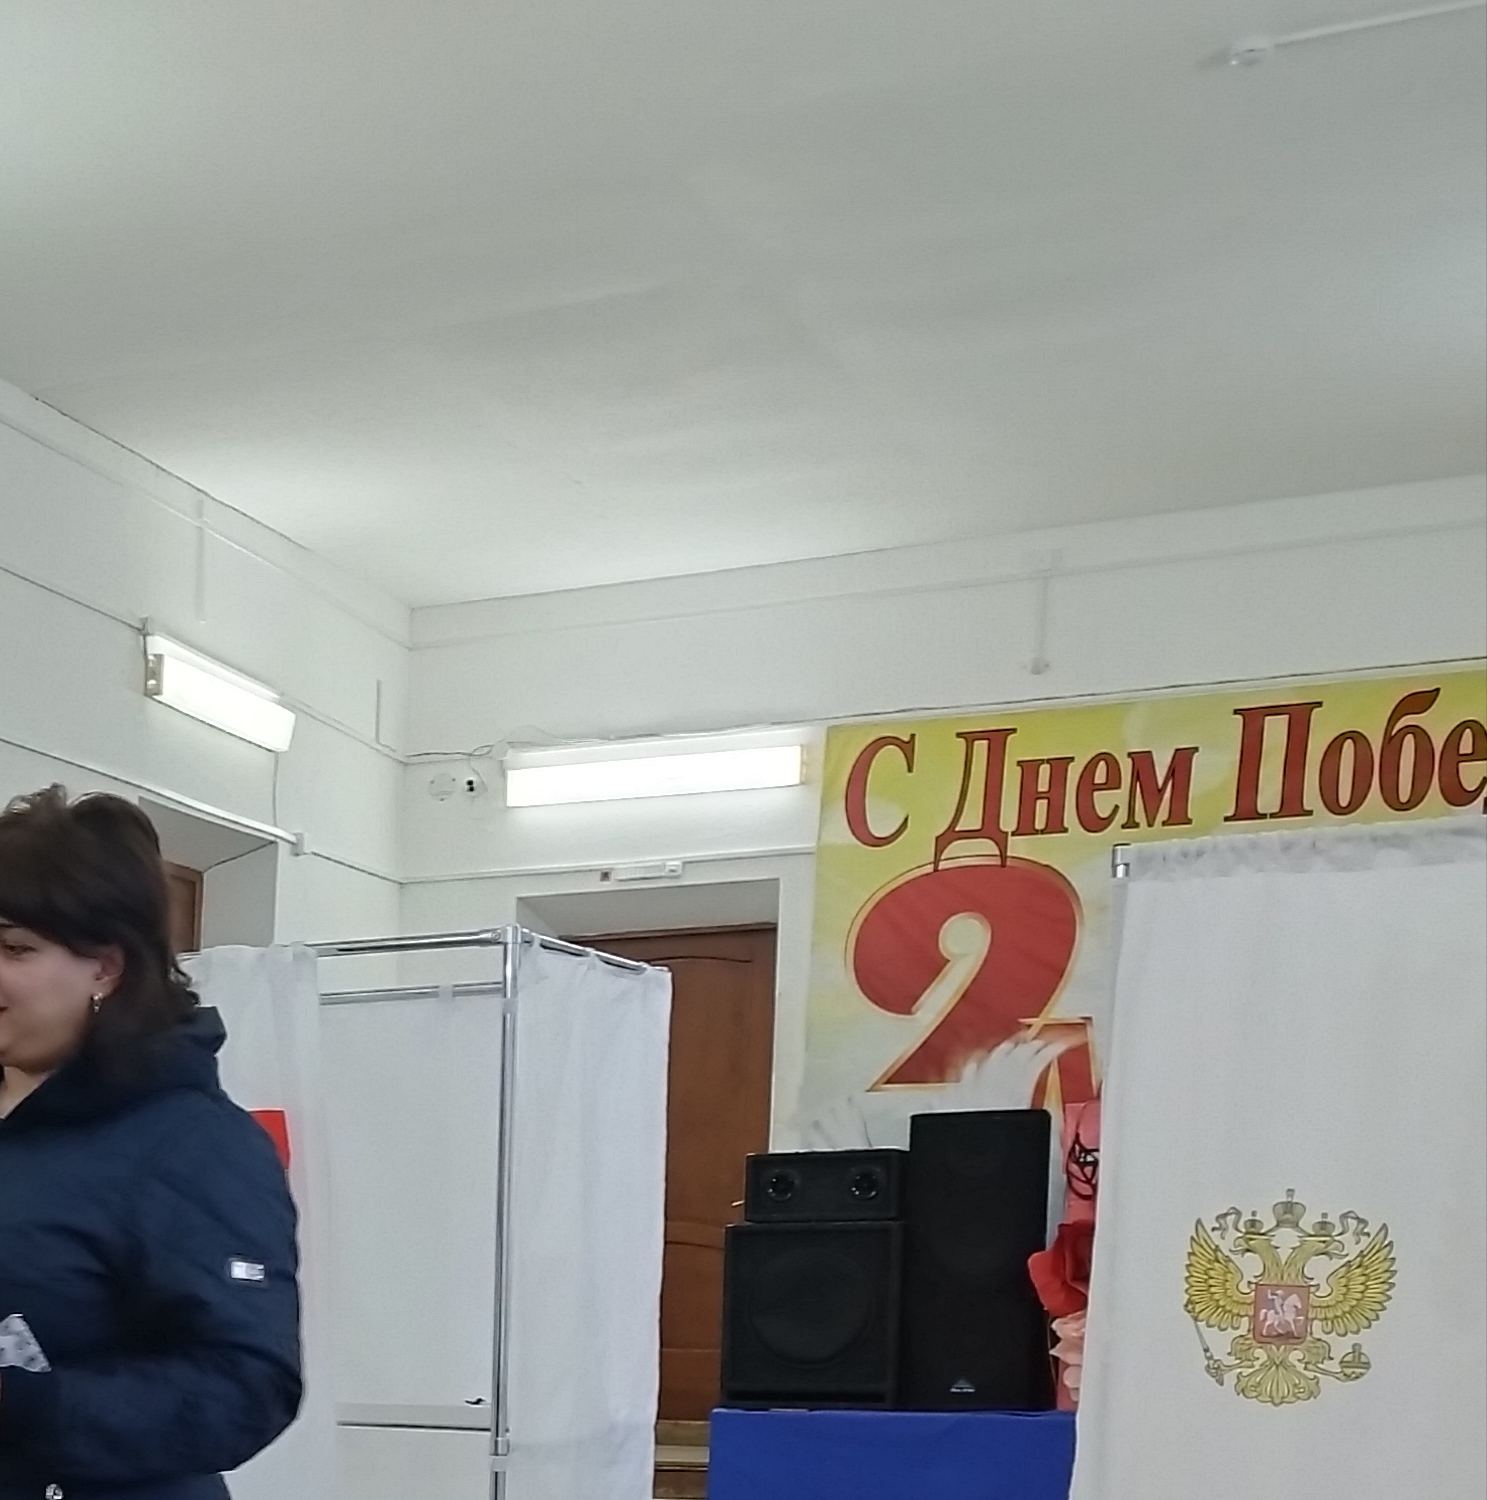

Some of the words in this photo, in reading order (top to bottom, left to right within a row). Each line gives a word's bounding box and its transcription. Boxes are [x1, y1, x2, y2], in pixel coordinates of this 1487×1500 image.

[845, 733, 916, 848] С
[934, 728, 1200, 873] Днем
[1223, 687, 1487, 823] Побе
